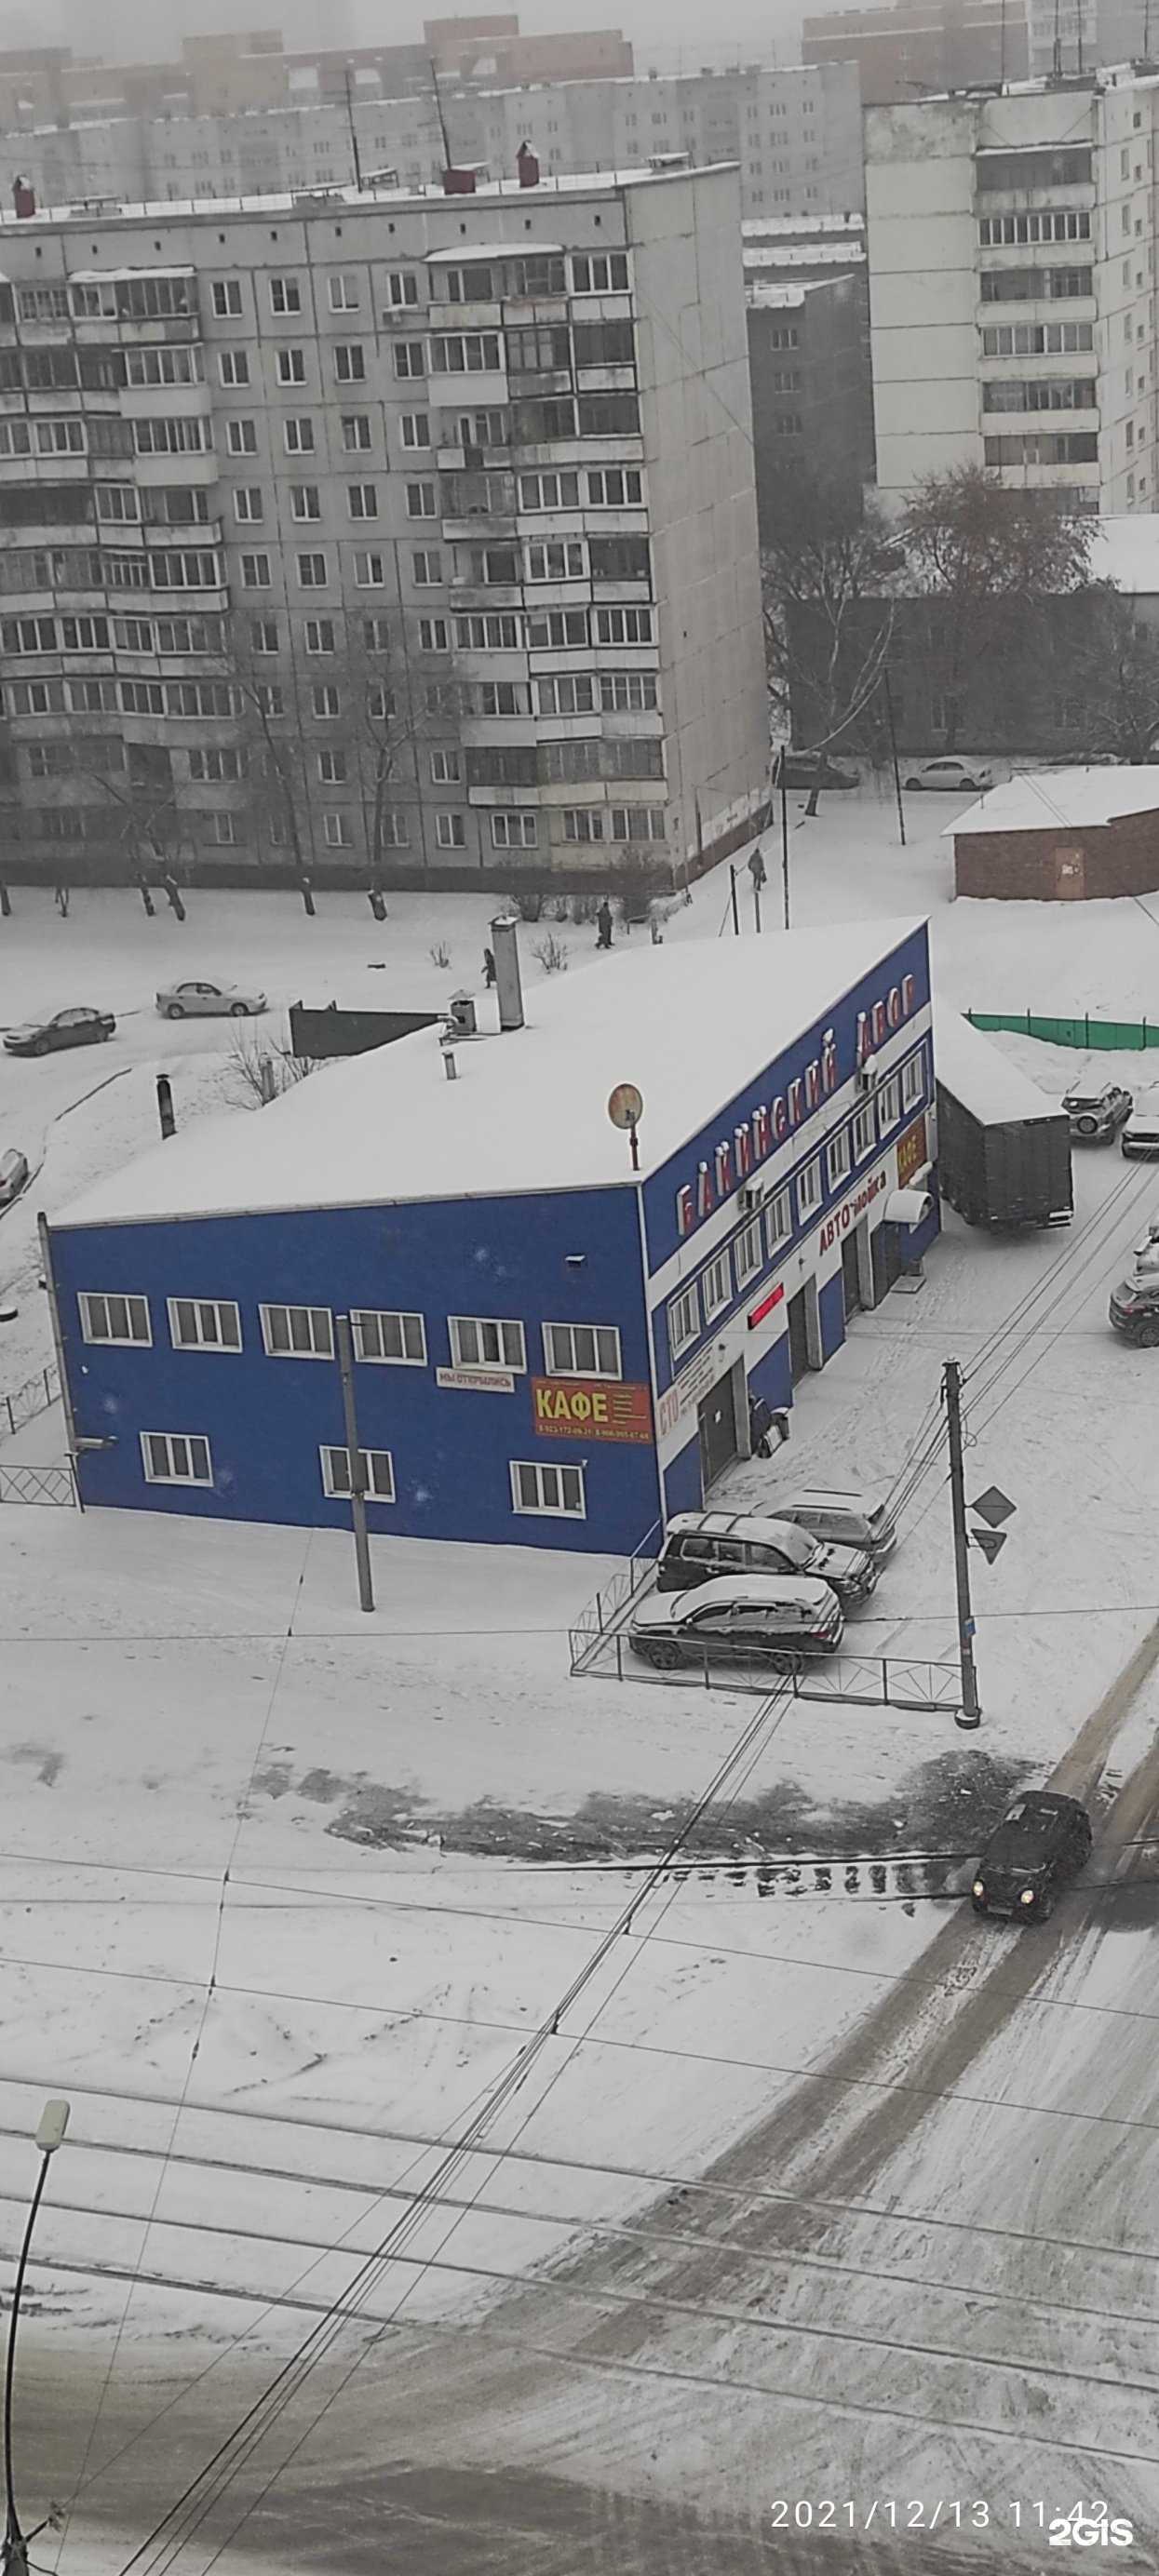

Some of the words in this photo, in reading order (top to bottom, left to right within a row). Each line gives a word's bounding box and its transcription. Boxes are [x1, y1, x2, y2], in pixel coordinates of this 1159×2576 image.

[677, 1028, 836, 1236] БАКИНСКИЙ
[856, 974, 913, 1070] ДВОР
[536, 1388, 609, 1423] КАФЕ
